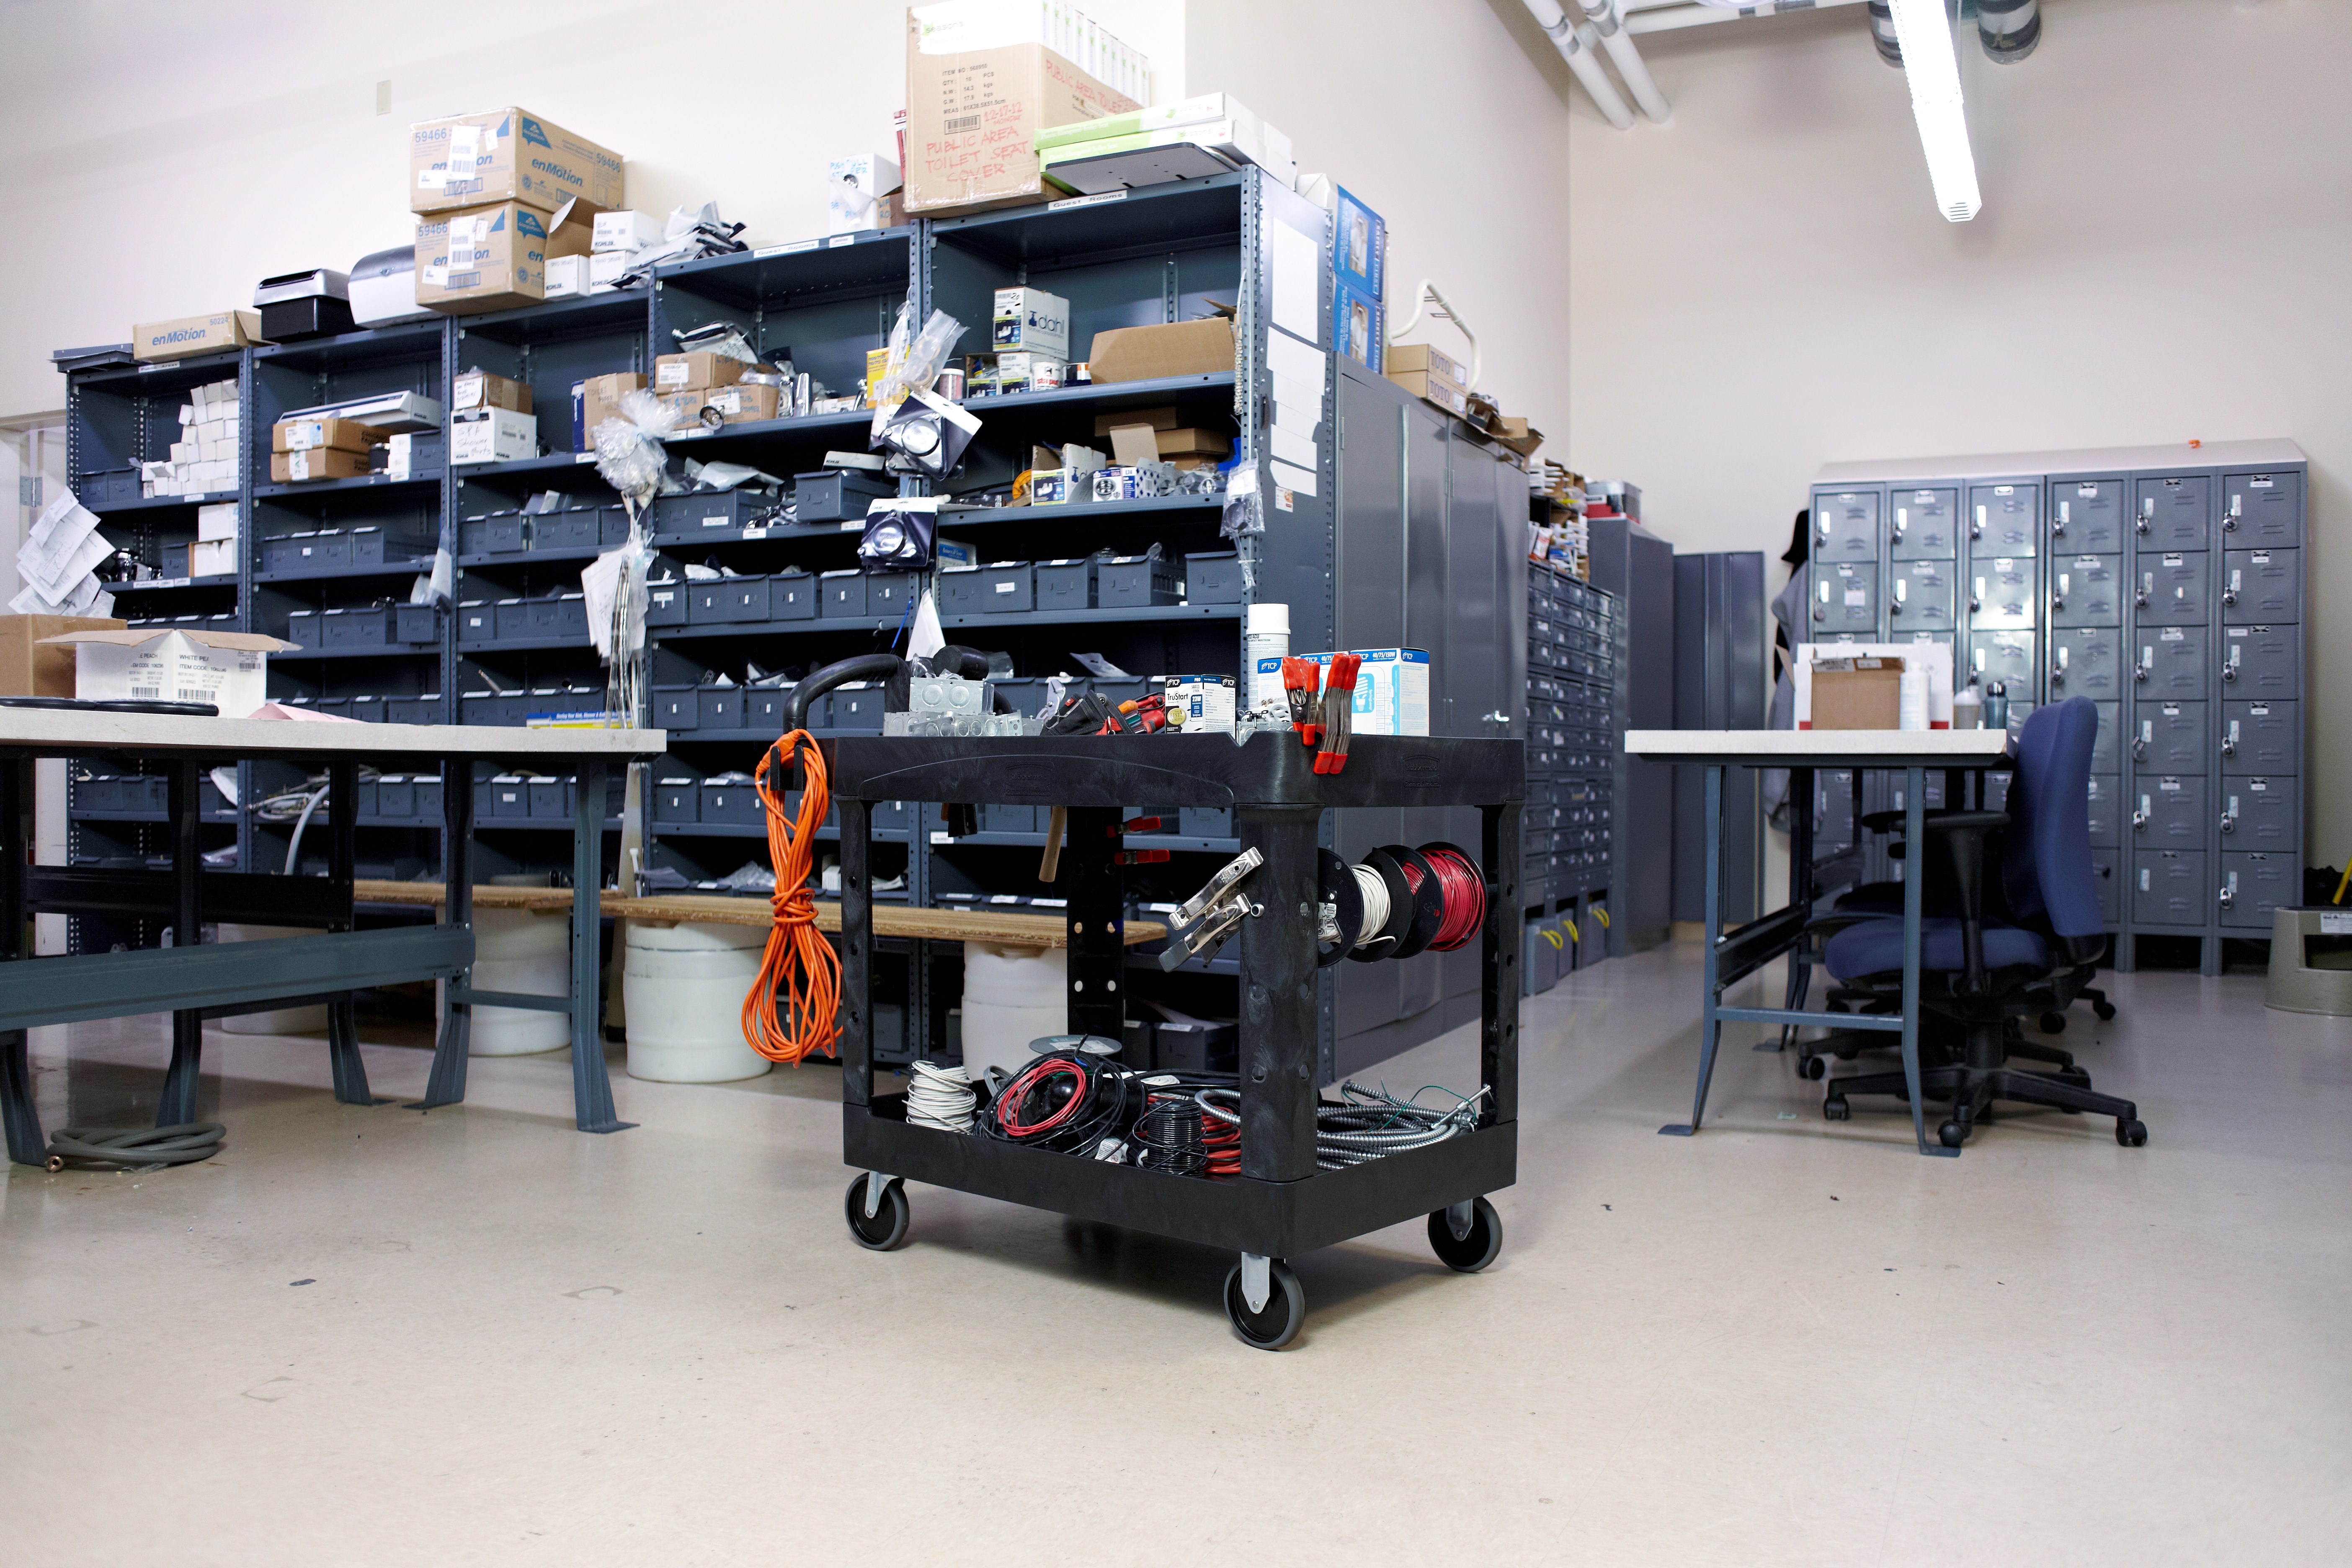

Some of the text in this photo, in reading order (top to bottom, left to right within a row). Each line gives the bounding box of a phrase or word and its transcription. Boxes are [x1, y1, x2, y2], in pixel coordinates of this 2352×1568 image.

[415, 128, 447, 143] 59466
[926, 126, 1019, 156] PUBLIC AREA
[925, 141, 1028, 173] TOILET SEAT
[532, 158, 583, 187] enMotion
[947, 163, 1005, 182] COVER
[1053, 192, 1123, 208] Guest Rooms
[419, 222, 448, 237] 59466
[210, 317, 229, 326] 50224
[1039, 315, 1064, 334] dahl
[152, 327, 206, 346] enMotion
[1431, 351, 1450, 375] TOTO
[1430, 380, 1449, 403] TOTO
